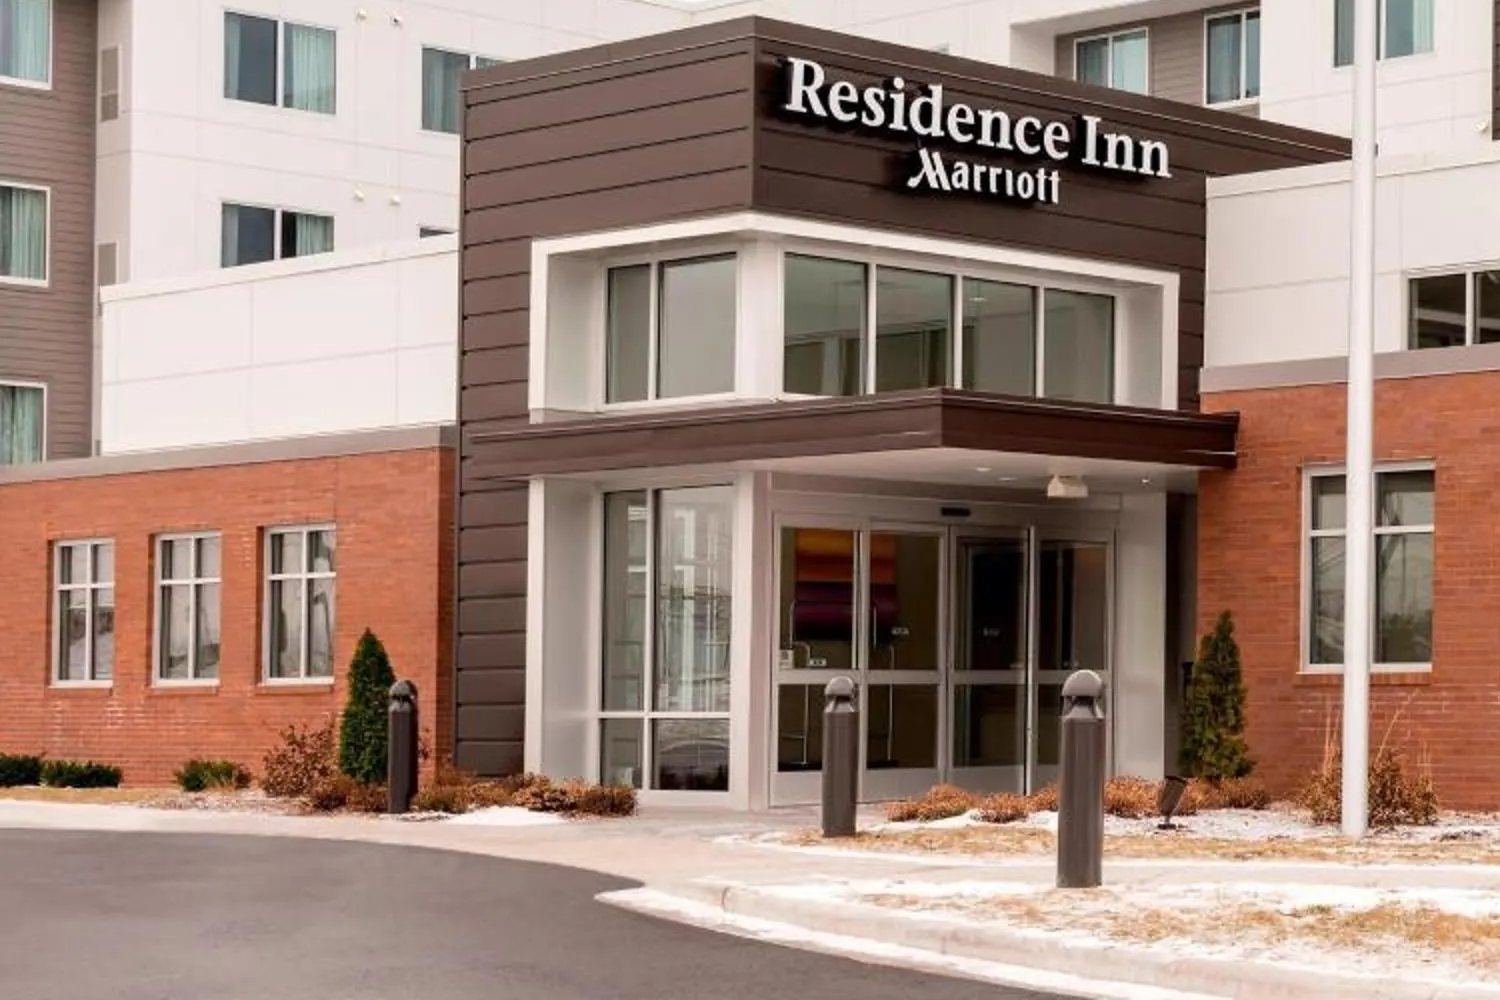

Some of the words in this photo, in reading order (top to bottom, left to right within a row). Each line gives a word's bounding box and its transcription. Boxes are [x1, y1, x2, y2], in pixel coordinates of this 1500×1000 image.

[784, 56, 1070, 160] Residence
[1080, 114, 1173, 178] Inn
[906, 147, 1061, 204] Marriott
